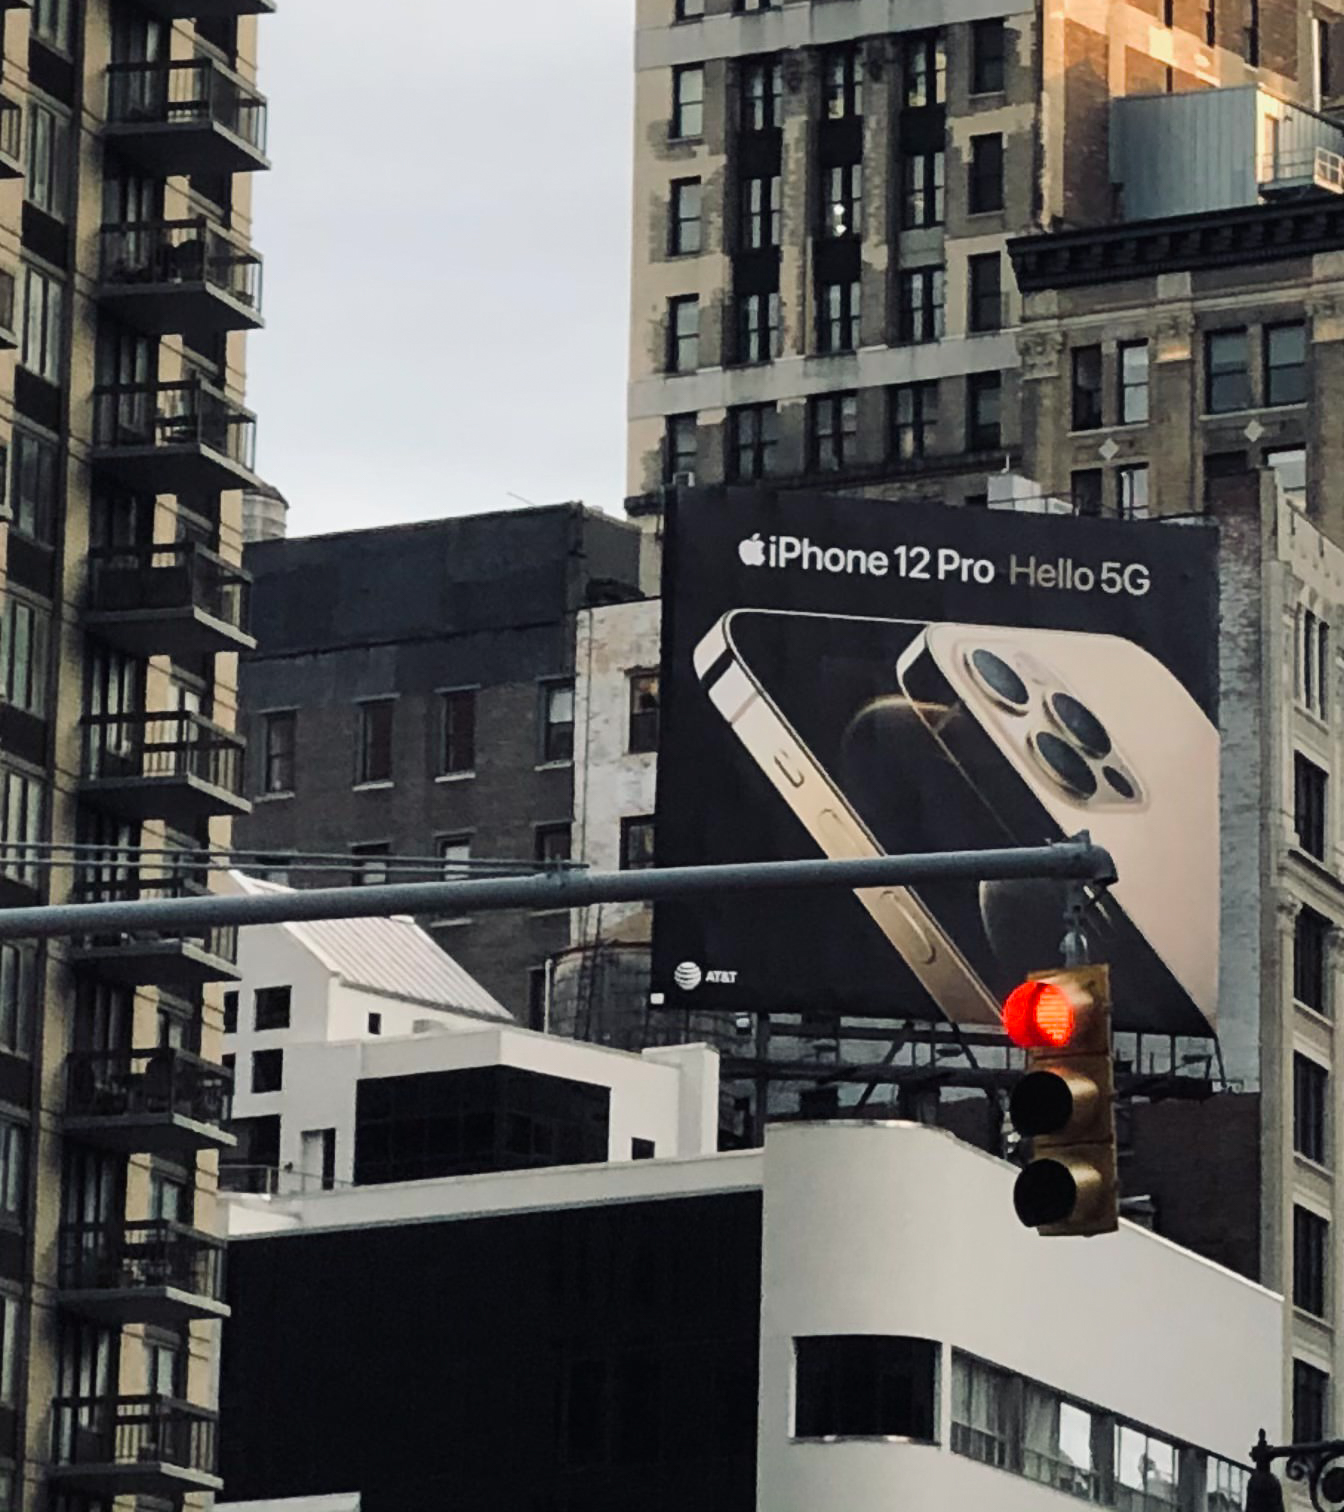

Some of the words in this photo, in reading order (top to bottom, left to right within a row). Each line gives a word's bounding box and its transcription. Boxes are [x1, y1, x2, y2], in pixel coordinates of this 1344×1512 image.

[769, 535, 889, 577] iPhone
[895, 545, 930, 579] 12
[938, 549, 995, 584] Pro
[1010, 555, 1096, 591] Hello
[1101, 562, 1151, 596] 5G
[705, 970, 738, 984] AT&T
